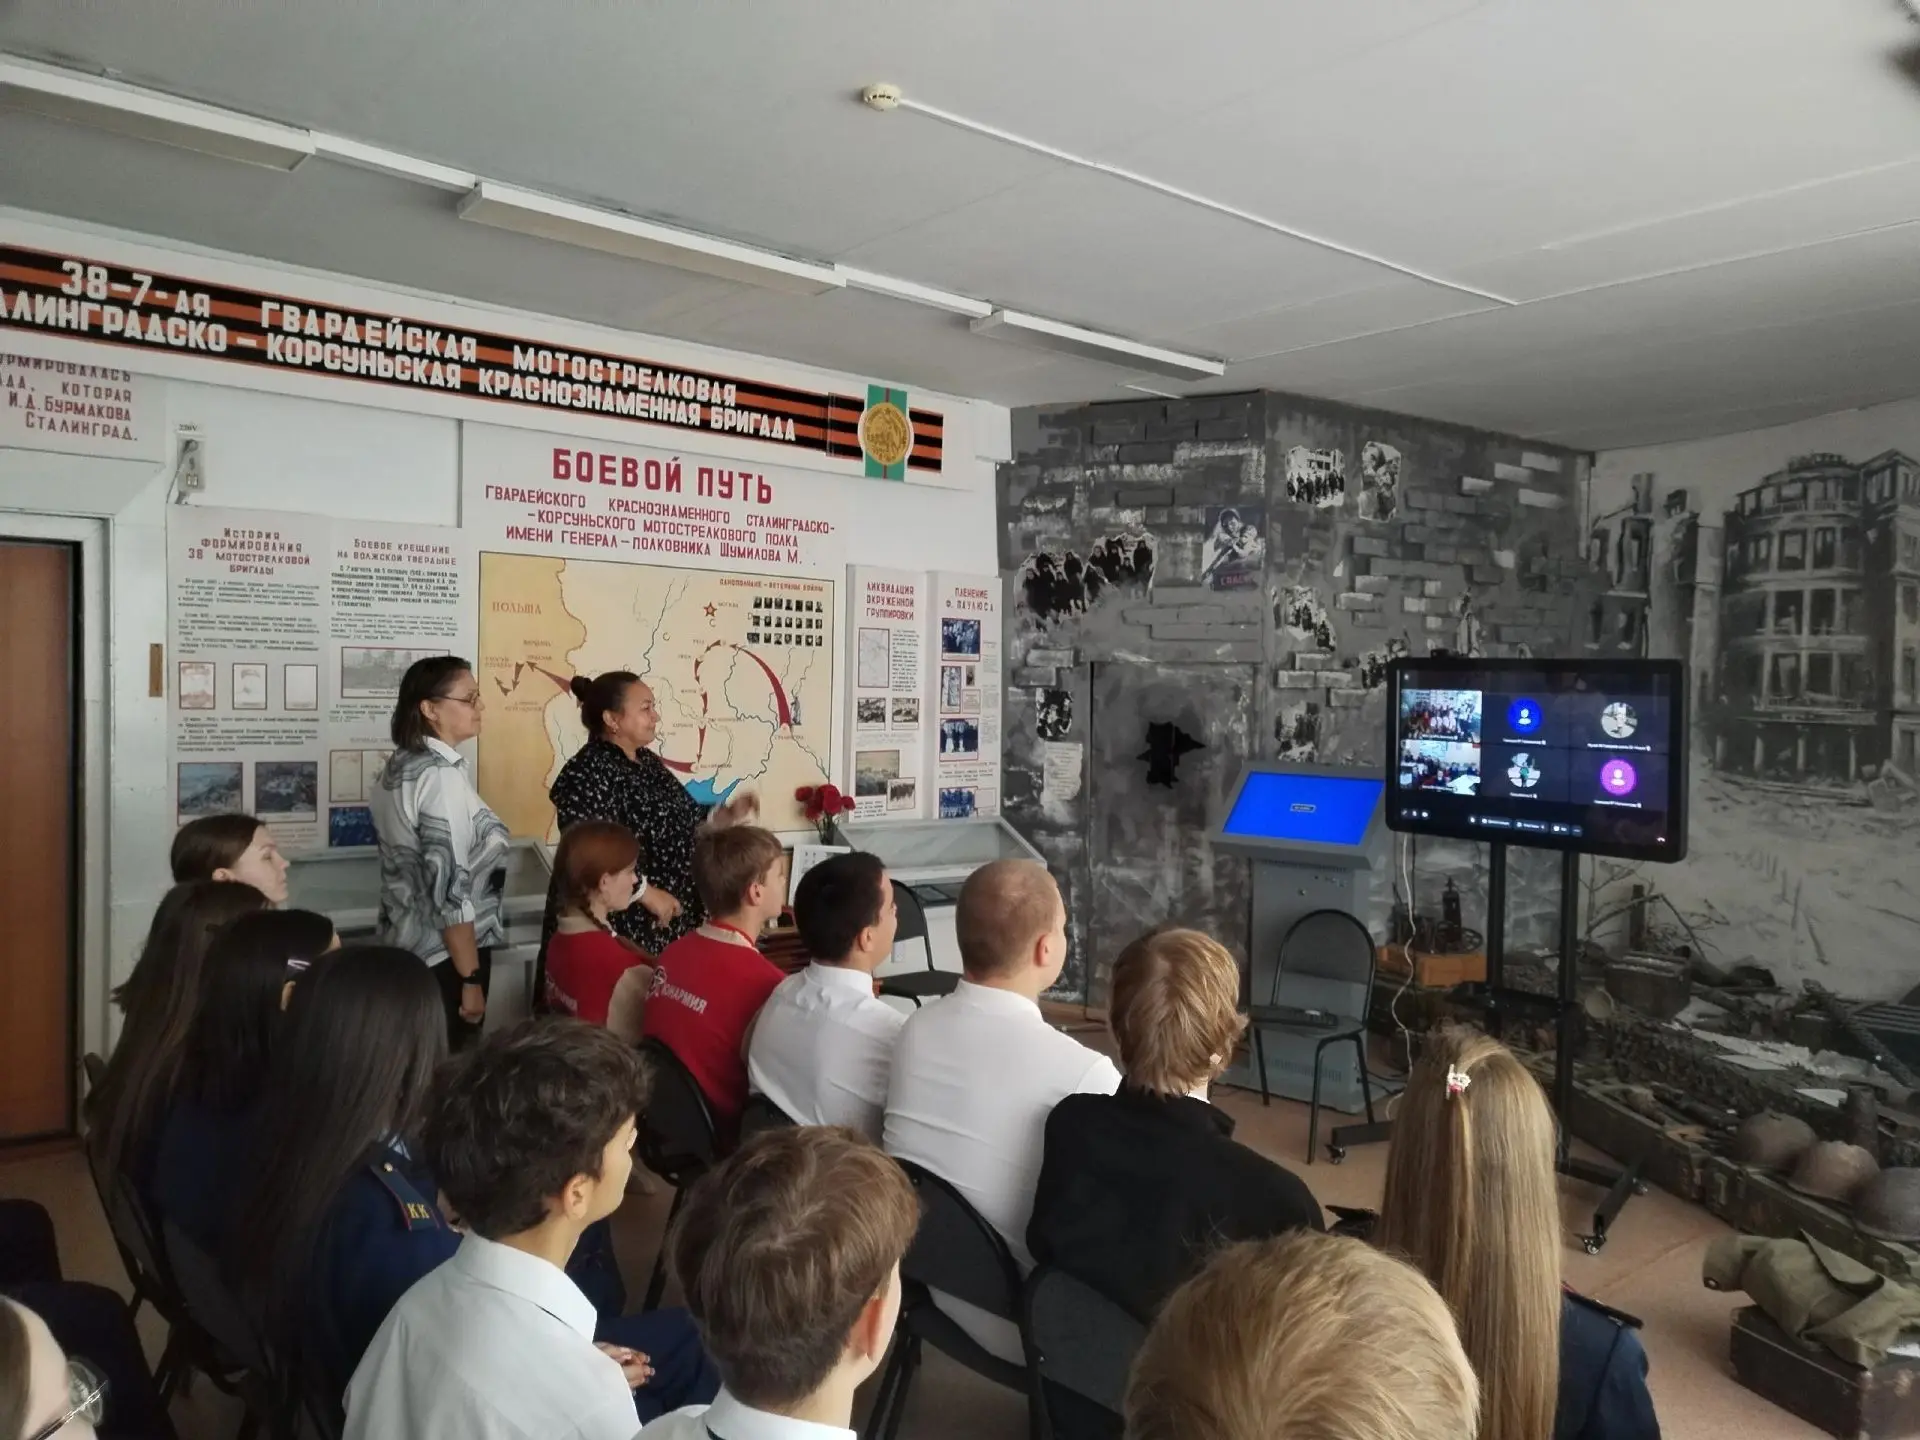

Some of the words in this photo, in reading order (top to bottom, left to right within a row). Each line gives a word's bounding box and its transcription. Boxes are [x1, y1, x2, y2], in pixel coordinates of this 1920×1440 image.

[261, 300, 477, 364] ГВАРДЕЙСКАЯ
[512, 344, 737, 407] МОТОСТРЕЛКОВАЯ
[62, 381, 132, 403] КОТОРАЯ
[478, 367, 702, 427] КРАСНОЗНАМЕННАЯ
[710, 405, 796, 442] БРИГАДА
[553, 448, 682, 493] БОЕВОЙ
[697, 466, 772, 504] ПУТЬ
[485, 484, 587, 508] ГВАРДЕЙСКОГО
[608, 498, 730, 524] КРАСНОЗНАМЕННОГО
[223, 527, 280, 540] ИСТОРИЯ
[643, 519, 757, 543] МОТОСТРЕЛКОВОГО
[765, 532, 799, 547] ПОЛКА
[201, 538, 302, 553] ФОРМИРОВАНИЯ
[354, 538, 392, 551] БОЕВОЕ
[397, 543, 450, 555] КРЕЩЕНИЕ
[506, 525, 553, 543] ИМЕНИ
[720, 542, 781, 562] ШУМИЛОВА
[188, 548, 203, 560] 38
[215, 552, 311, 565] МОТОСТРЕЛКОВОЙ
[337, 550, 348, 559] НА
[353, 551, 403, 562] ВОЛЖСКОЙ
[407, 556, 457, 566] ТВЕРДЫНЕ
[229, 564, 274, 575] БРИГАДЫ
[866, 581, 915, 595] ЛИКВИДАЦИЯ
[954, 587, 989, 600] ПЛЕНЕНИЕ
[492, 601, 542, 615] ПОЛЬША
[866, 594, 914, 608] ОКРУЖЕННОЙ
[956, 600, 994, 613] ПАУЛЮСА
[866, 607, 914, 621] ГРУППИРОВКИ
